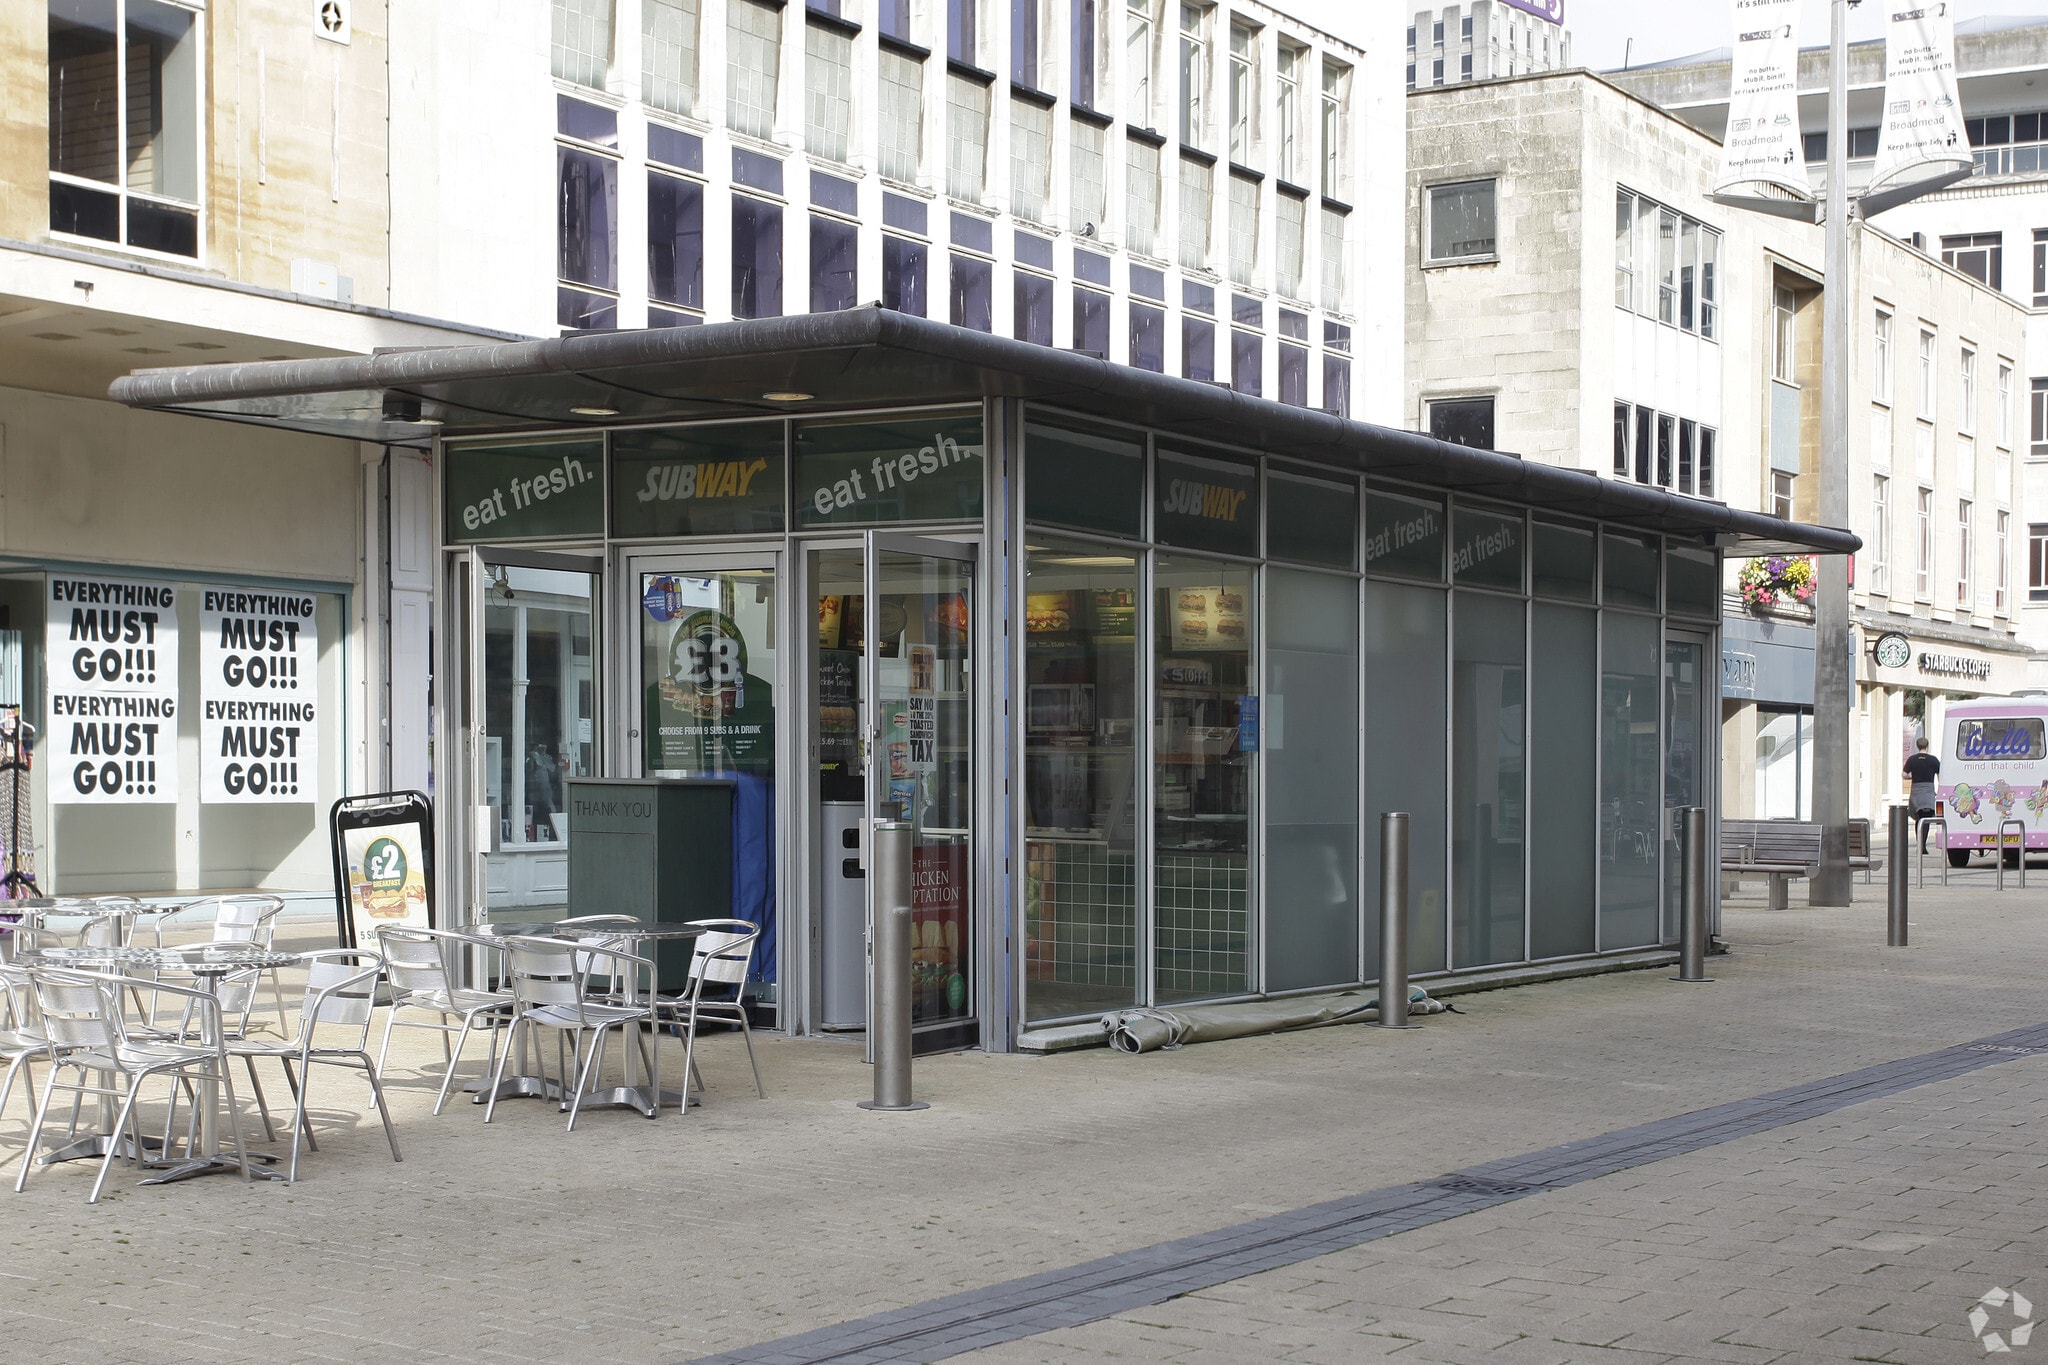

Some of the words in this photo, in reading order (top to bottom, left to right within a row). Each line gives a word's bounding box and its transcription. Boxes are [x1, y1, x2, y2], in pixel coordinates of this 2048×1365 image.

[1890, 116, 1945, 131] Broadmead
[1732, 133, 1783, 148] Broadmead
[1888, 144, 1904, 152] Keep
[1906, 140, 1928, 149] Britain
[1930, 138, 1943, 146] Tidy
[1728, 160, 1744, 168] Keep
[1744, 157, 1766, 165] Britain
[637, 456, 767, 503] SUBWAY
[815, 467, 866, 515] eat
[871, 432, 970, 492] fresh.
[462, 487, 508, 531] eat
[510, 455, 594, 508] fresh.
[1163, 477, 1246, 522] SUBWAY
[1366, 526, 1391, 561] eat
[1394, 508, 1438, 550] fresh.
[1453, 545, 1474, 575] eat
[1475, 522, 1516, 562] fresh.
[52, 580, 174, 608] EVERYTHING
[204, 591, 314, 618] EVERYTHING
[69, 608, 158, 644] MUST
[220, 618, 300, 652] MUST
[72, 647, 156, 684] GO!!!
[674, 638, 742, 683] £3
[820, 662, 834, 673] weet
[1722, 658, 1755, 683] vans
[1925, 653, 1968, 673] STARBUCKS
[1968, 659, 1992, 676] COFFEE
[222, 654, 298, 690] GO!!!
[912, 672, 932, 690] TAX
[53, 695, 174, 718] EVERYTHING
[206, 700, 314, 722] EVERYTHING
[910, 697, 923, 710] SAY
[924, 697, 934, 710] NO
[910, 711, 916, 719] TO
[916, 711, 924, 719] THE
[910, 720, 934, 730] TOASTED
[70, 722, 158, 756] MUST
[658, 726, 684, 736] CHOOSE
[684, 726, 703, 736] FROM
[704, 726, 709, 735] 9
[710, 726, 727, 735] SUBS
[728, 726, 734, 734] &
[734, 726, 740, 734] A
[741, 724, 762, 734] DRINK
[910, 730, 934, 739] SANDWICH
[221, 726, 300, 758] MUST
[820, 738, 835, 746] 5.69
[910, 740, 934, 762] TAX
[1964, 762, 1986, 770] mind
[2014, 761, 2036, 770] child
[73, 760, 156, 795] GO!!!
[224, 762, 298, 796] GO!!!
[574, 800, 618, 817] THANK
[622, 802, 652, 818] YOU
[371, 844, 400, 880] £2
[918, 860, 932, 868] THE
[373, 880, 400, 888] BREAKFAST
[912, 870, 949, 886] HICKEN
[913, 886, 959, 904] PTATION
[360, 932, 365, 940] 5
